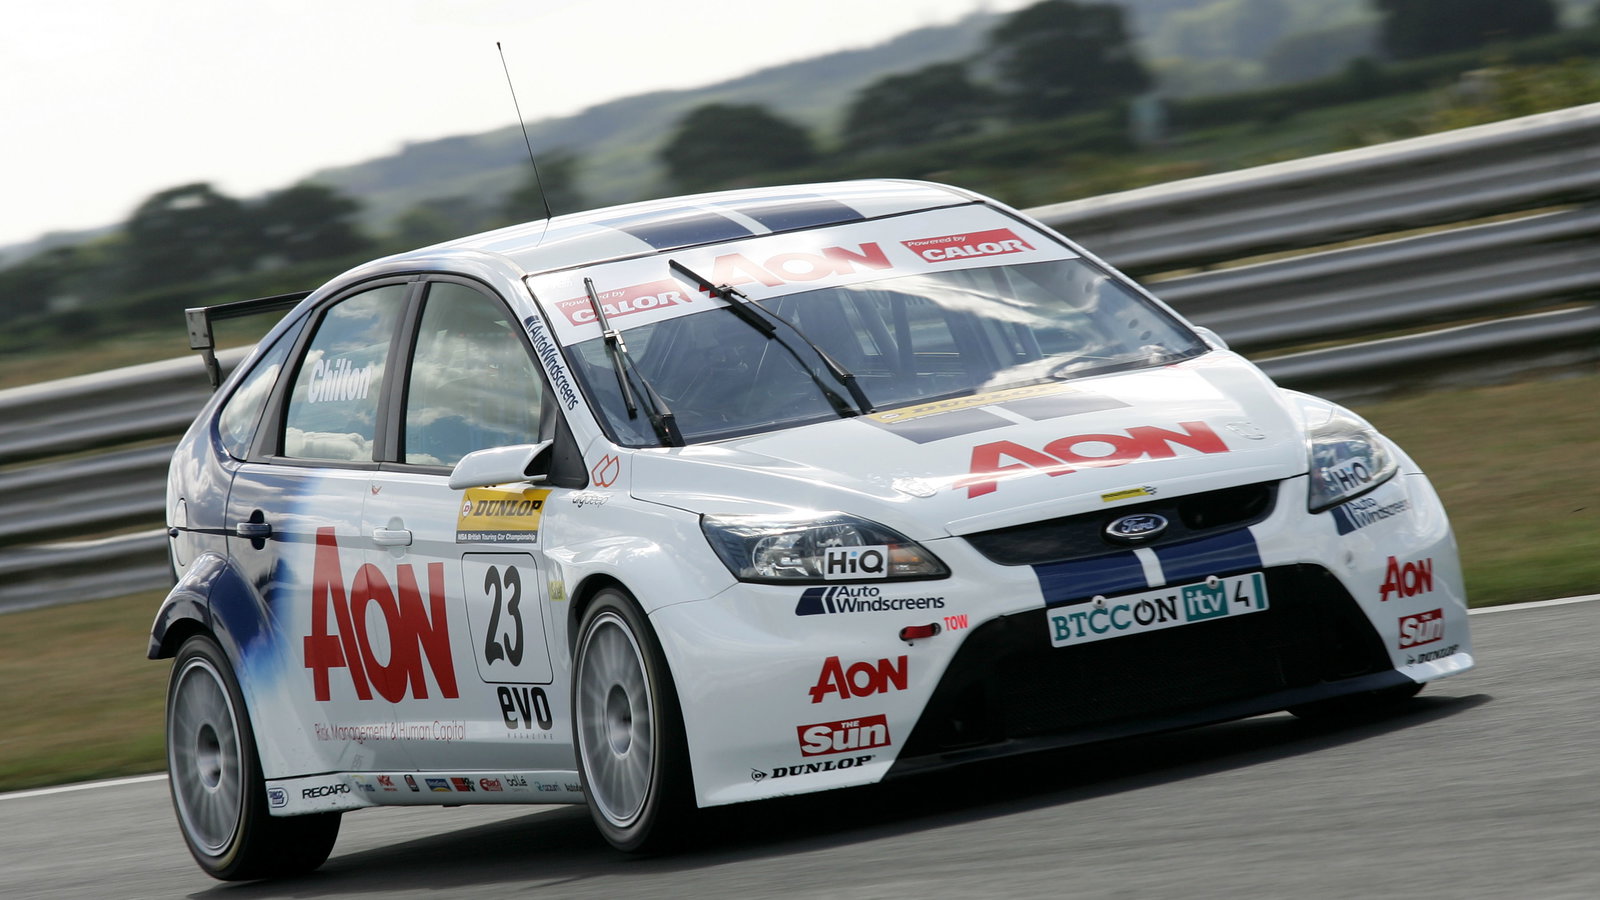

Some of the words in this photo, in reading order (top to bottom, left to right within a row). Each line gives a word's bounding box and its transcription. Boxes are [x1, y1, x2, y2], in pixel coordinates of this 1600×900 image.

[907, 237, 952, 247] Powered
[922, 239, 1029, 261] CALOR
[699, 242, 894, 298] AON
[611, 290, 625, 298] by
[572, 290, 689, 323] CALOR
[308, 358, 372, 404] Chilton
[952, 421, 1230, 499] AON
[1334, 462, 1371, 492] HiQ
[473, 499, 543, 517] DUNLOP
[1121, 517, 1155, 533] Ford
[482, 533, 497, 542] Touring
[506, 533, 536, 542] Championship
[828, 550, 884, 574] HiQ
[1379, 556, 1434, 601] AON
[836, 585, 880, 598] Auto
[1186, 589, 1223, 615] itv
[1233, 580, 1251, 608] 4
[303, 526, 460, 703] AON
[485, 565, 524, 667] 23
[836, 595, 945, 613] Windscreens
[944, 614, 969, 632] TOW
[1400, 617, 1444, 646] Sun
[809, 655, 908, 704] AON
[497, 686, 553, 731] evo
[314, 723, 330, 741] Risk
[330, 721, 388, 744] Management
[390, 722, 398, 740] &
[399, 721, 431, 741] Human
[432, 720, 466, 743] Capital
[841, 720, 860, 729] THE
[801, 723, 886, 755] Sun
[771, 755, 874, 779] DUNLOP
[302, 783, 351, 799] RECARO
